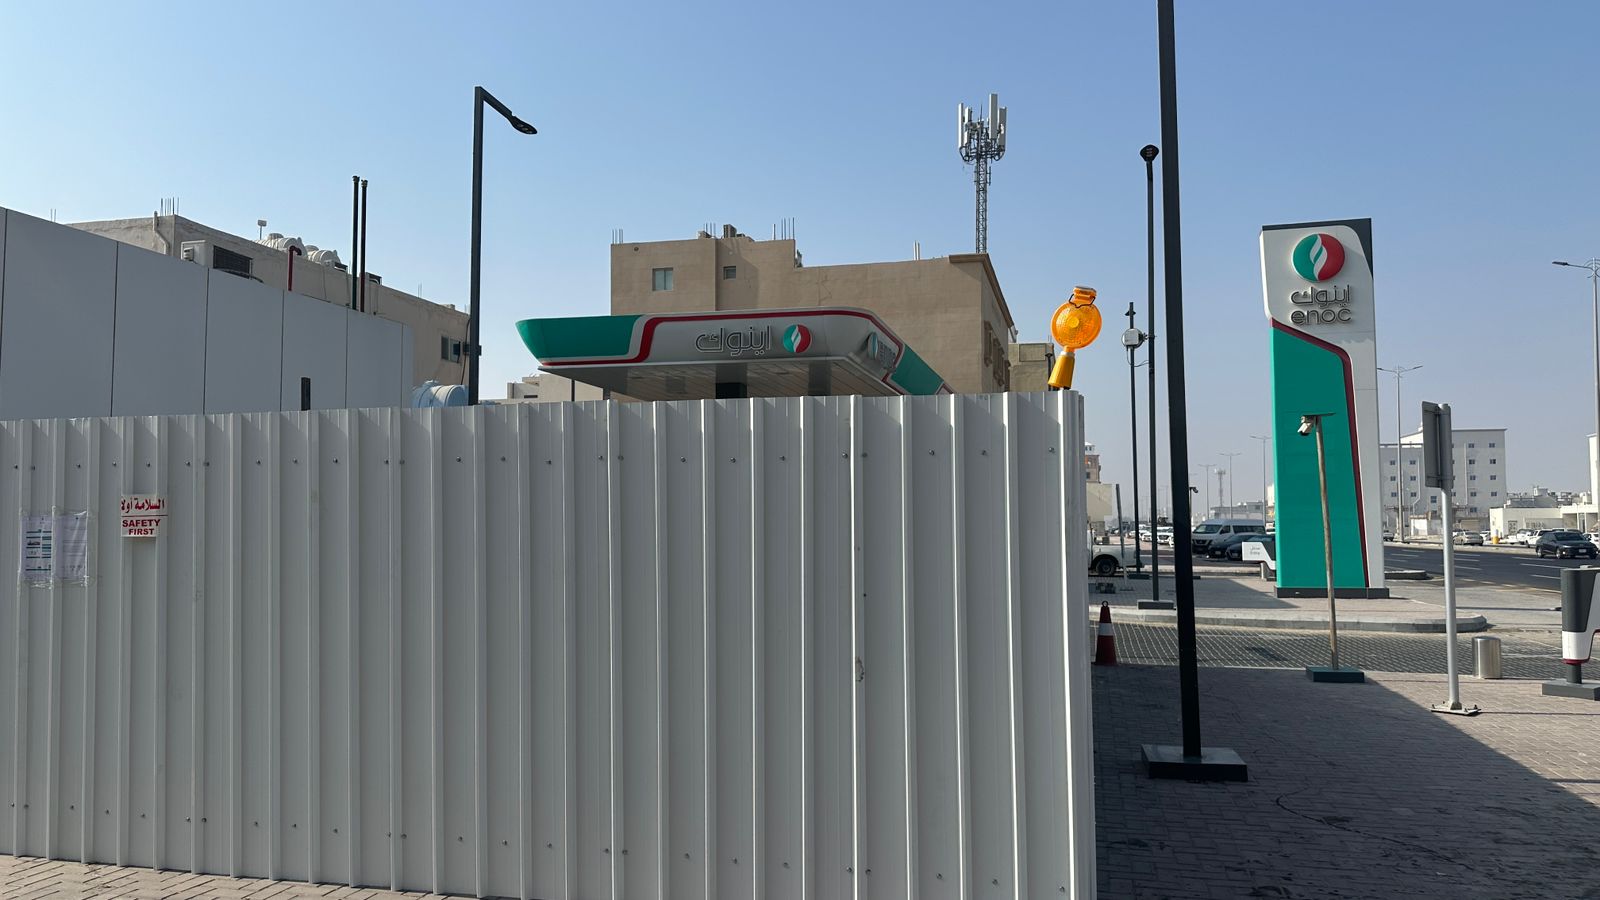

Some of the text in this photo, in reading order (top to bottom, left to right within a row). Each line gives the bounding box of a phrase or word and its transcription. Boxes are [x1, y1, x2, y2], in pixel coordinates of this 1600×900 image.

[1290, 308, 1351, 324] enoc
[134, 497, 165, 511] السلامة
[122, 519, 161, 527] SAFETY
